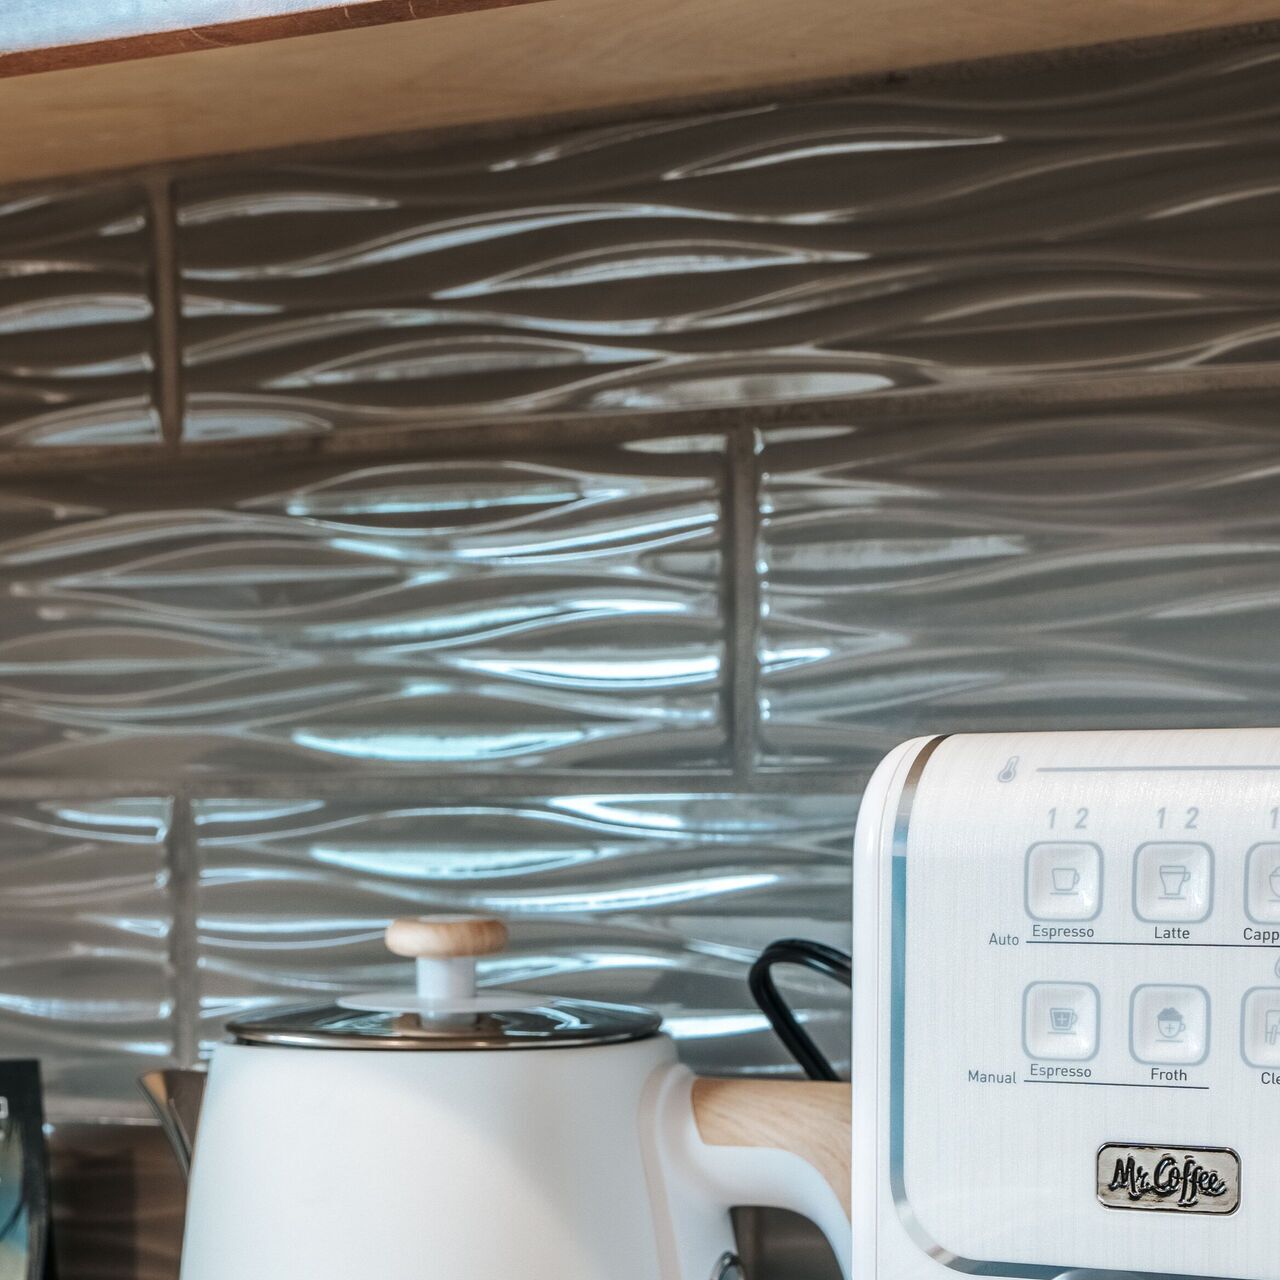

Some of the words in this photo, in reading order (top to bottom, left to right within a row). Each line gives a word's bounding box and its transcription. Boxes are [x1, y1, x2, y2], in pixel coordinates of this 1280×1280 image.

[1046, 806, 1057, 830] 1
[1074, 807, 1090, 830] 2
[1156, 806, 1167, 830] 1
[1184, 807, 1200, 830] 2
[1269, 806, 1280, 830] 1
[988, 932, 1020, 946] Auto
[1031, 924, 1095, 941] Espresso
[1153, 926, 1191, 940] Latte
[967, 1069, 1017, 1085] Manual
[1029, 1063, 1092, 1079] Espresso
[1150, 1067, 1188, 1082] Froth
[1108, 1155, 1151, 1200] Mr.
[1153, 1153, 1227, 1207] Coffee
